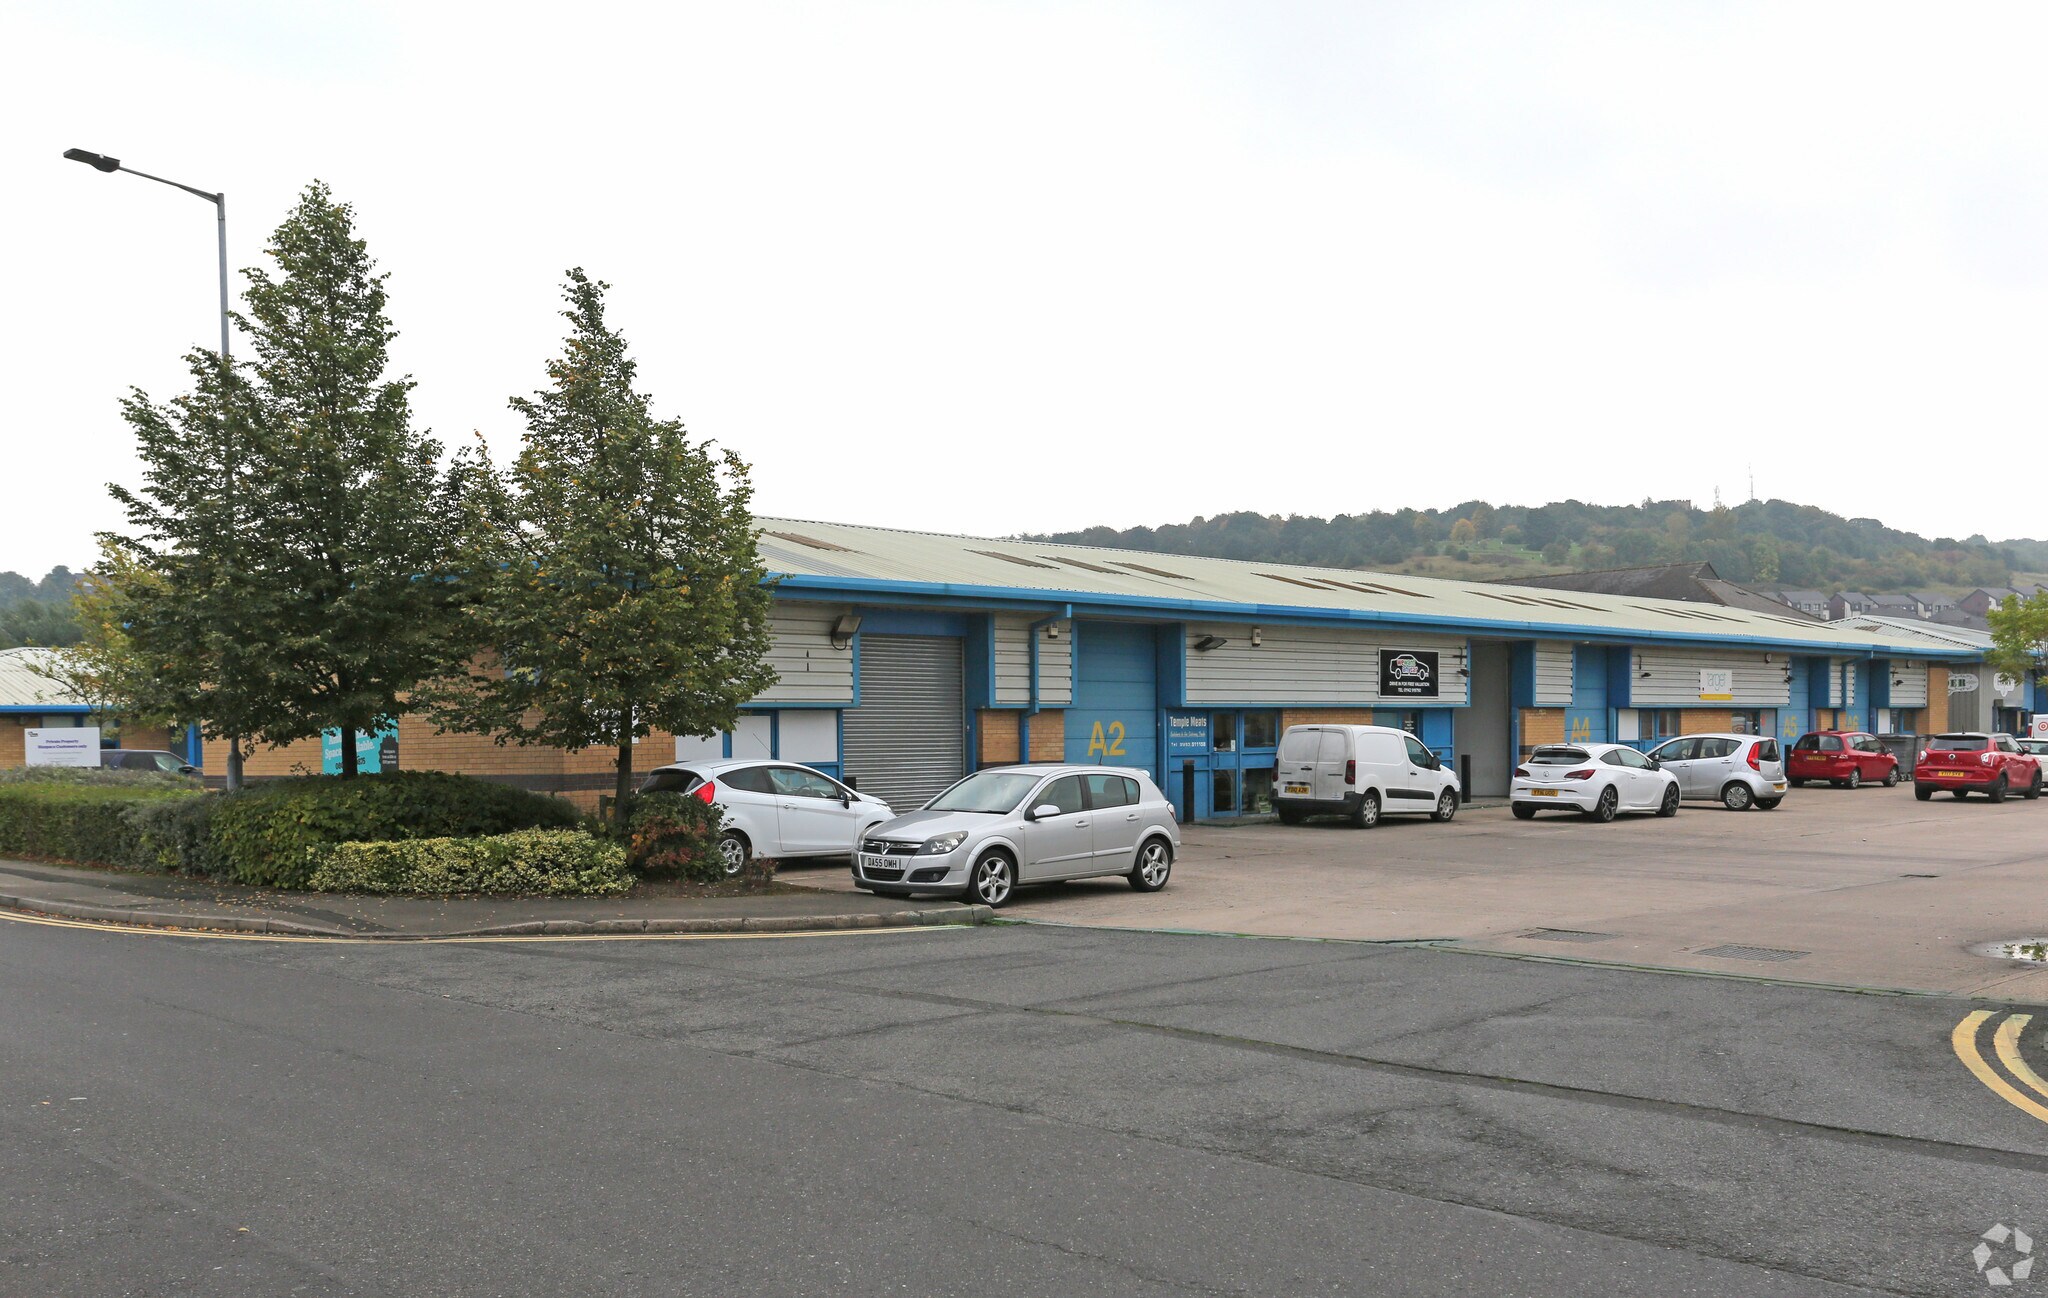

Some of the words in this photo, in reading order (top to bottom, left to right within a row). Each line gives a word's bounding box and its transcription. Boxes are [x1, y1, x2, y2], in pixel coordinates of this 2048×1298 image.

[1170, 716, 1190, 729] Temple
[1191, 716, 1207, 727] Meats
[1570, 717, 1591, 744] A4
[1783, 715, 1798, 738] A5
[1845, 714, 1859, 733] A6
[1088, 720, 1126, 756] A2
[868, 857, 882, 867] DA55
[884, 859, 897, 868] OMH
